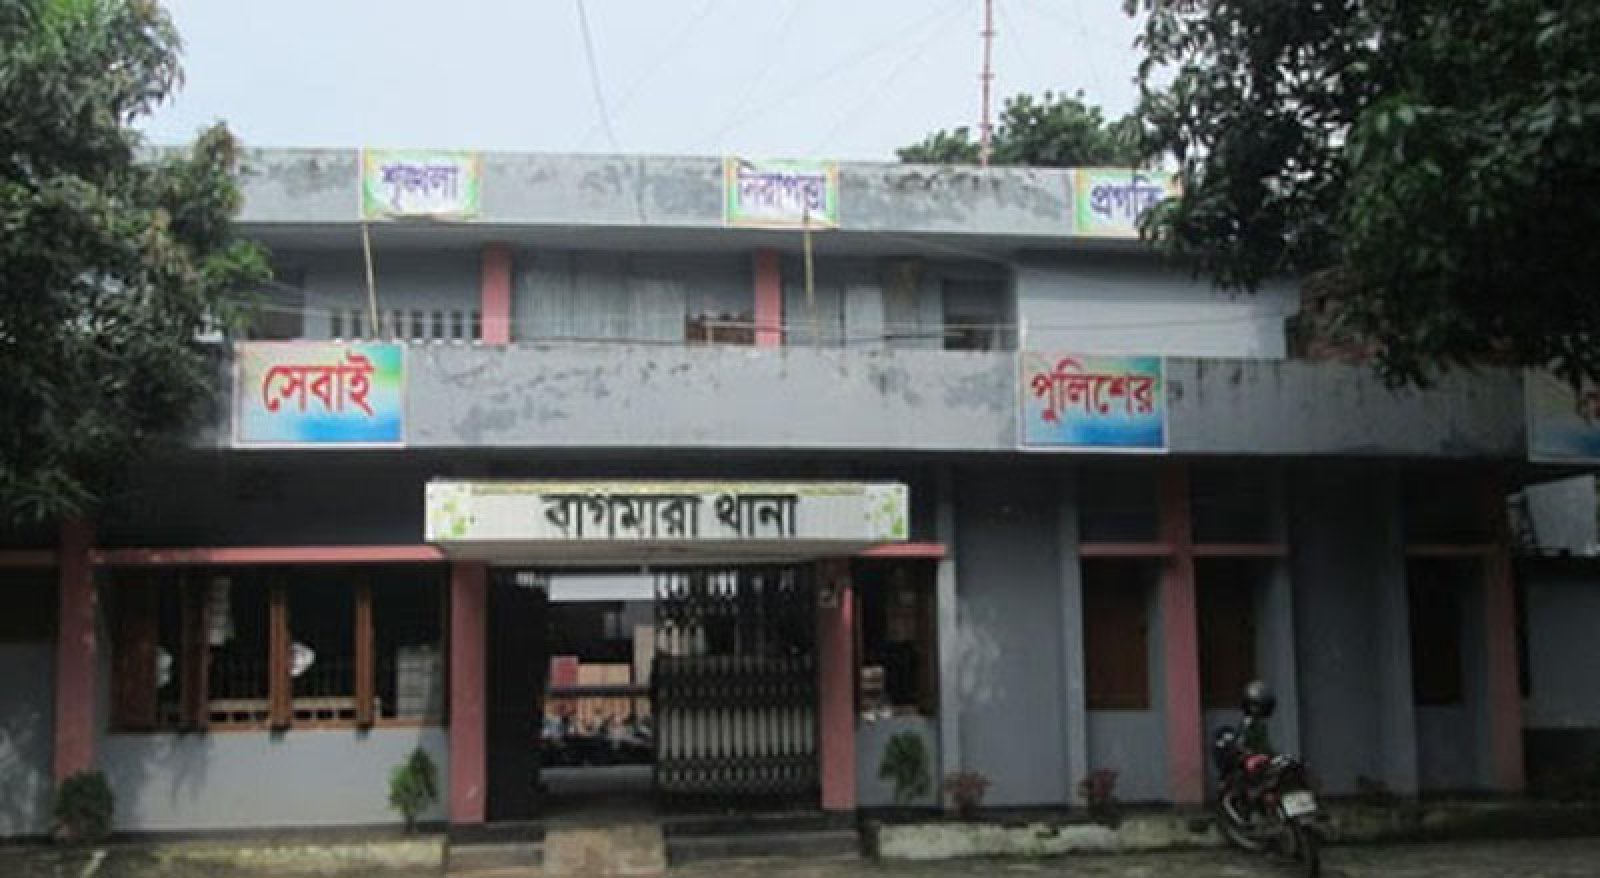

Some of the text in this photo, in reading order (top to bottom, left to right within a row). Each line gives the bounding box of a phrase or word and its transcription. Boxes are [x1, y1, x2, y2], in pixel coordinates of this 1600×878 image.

[262, 351, 375, 416] সেবাই
[1031, 358, 1154, 424] পুলিশের
[540, 492, 799, 540] বাগমারা থানা
